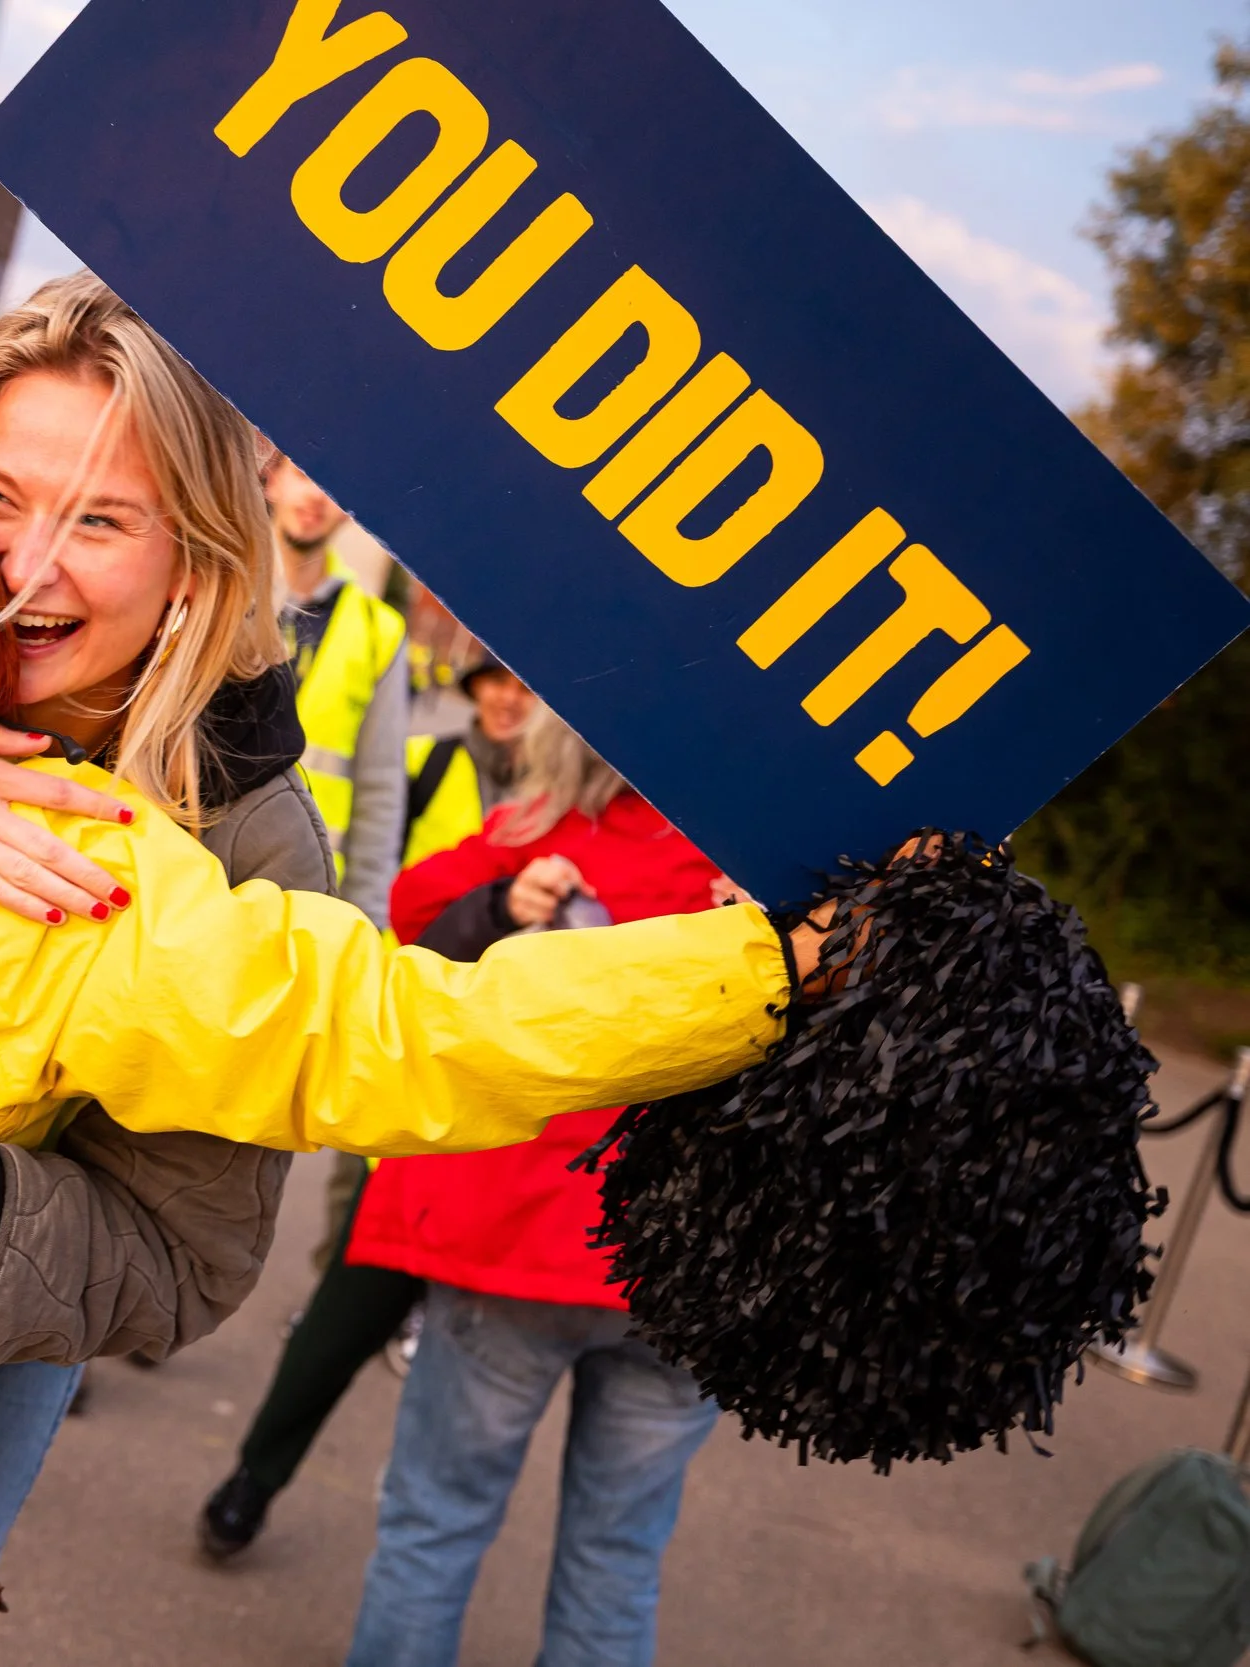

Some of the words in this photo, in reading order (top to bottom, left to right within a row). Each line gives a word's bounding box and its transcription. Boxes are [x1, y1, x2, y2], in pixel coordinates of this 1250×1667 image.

[214, 0, 593, 350] YOU
[495, 265, 823, 587] DID
[737, 507, 1030, 786] IT!
